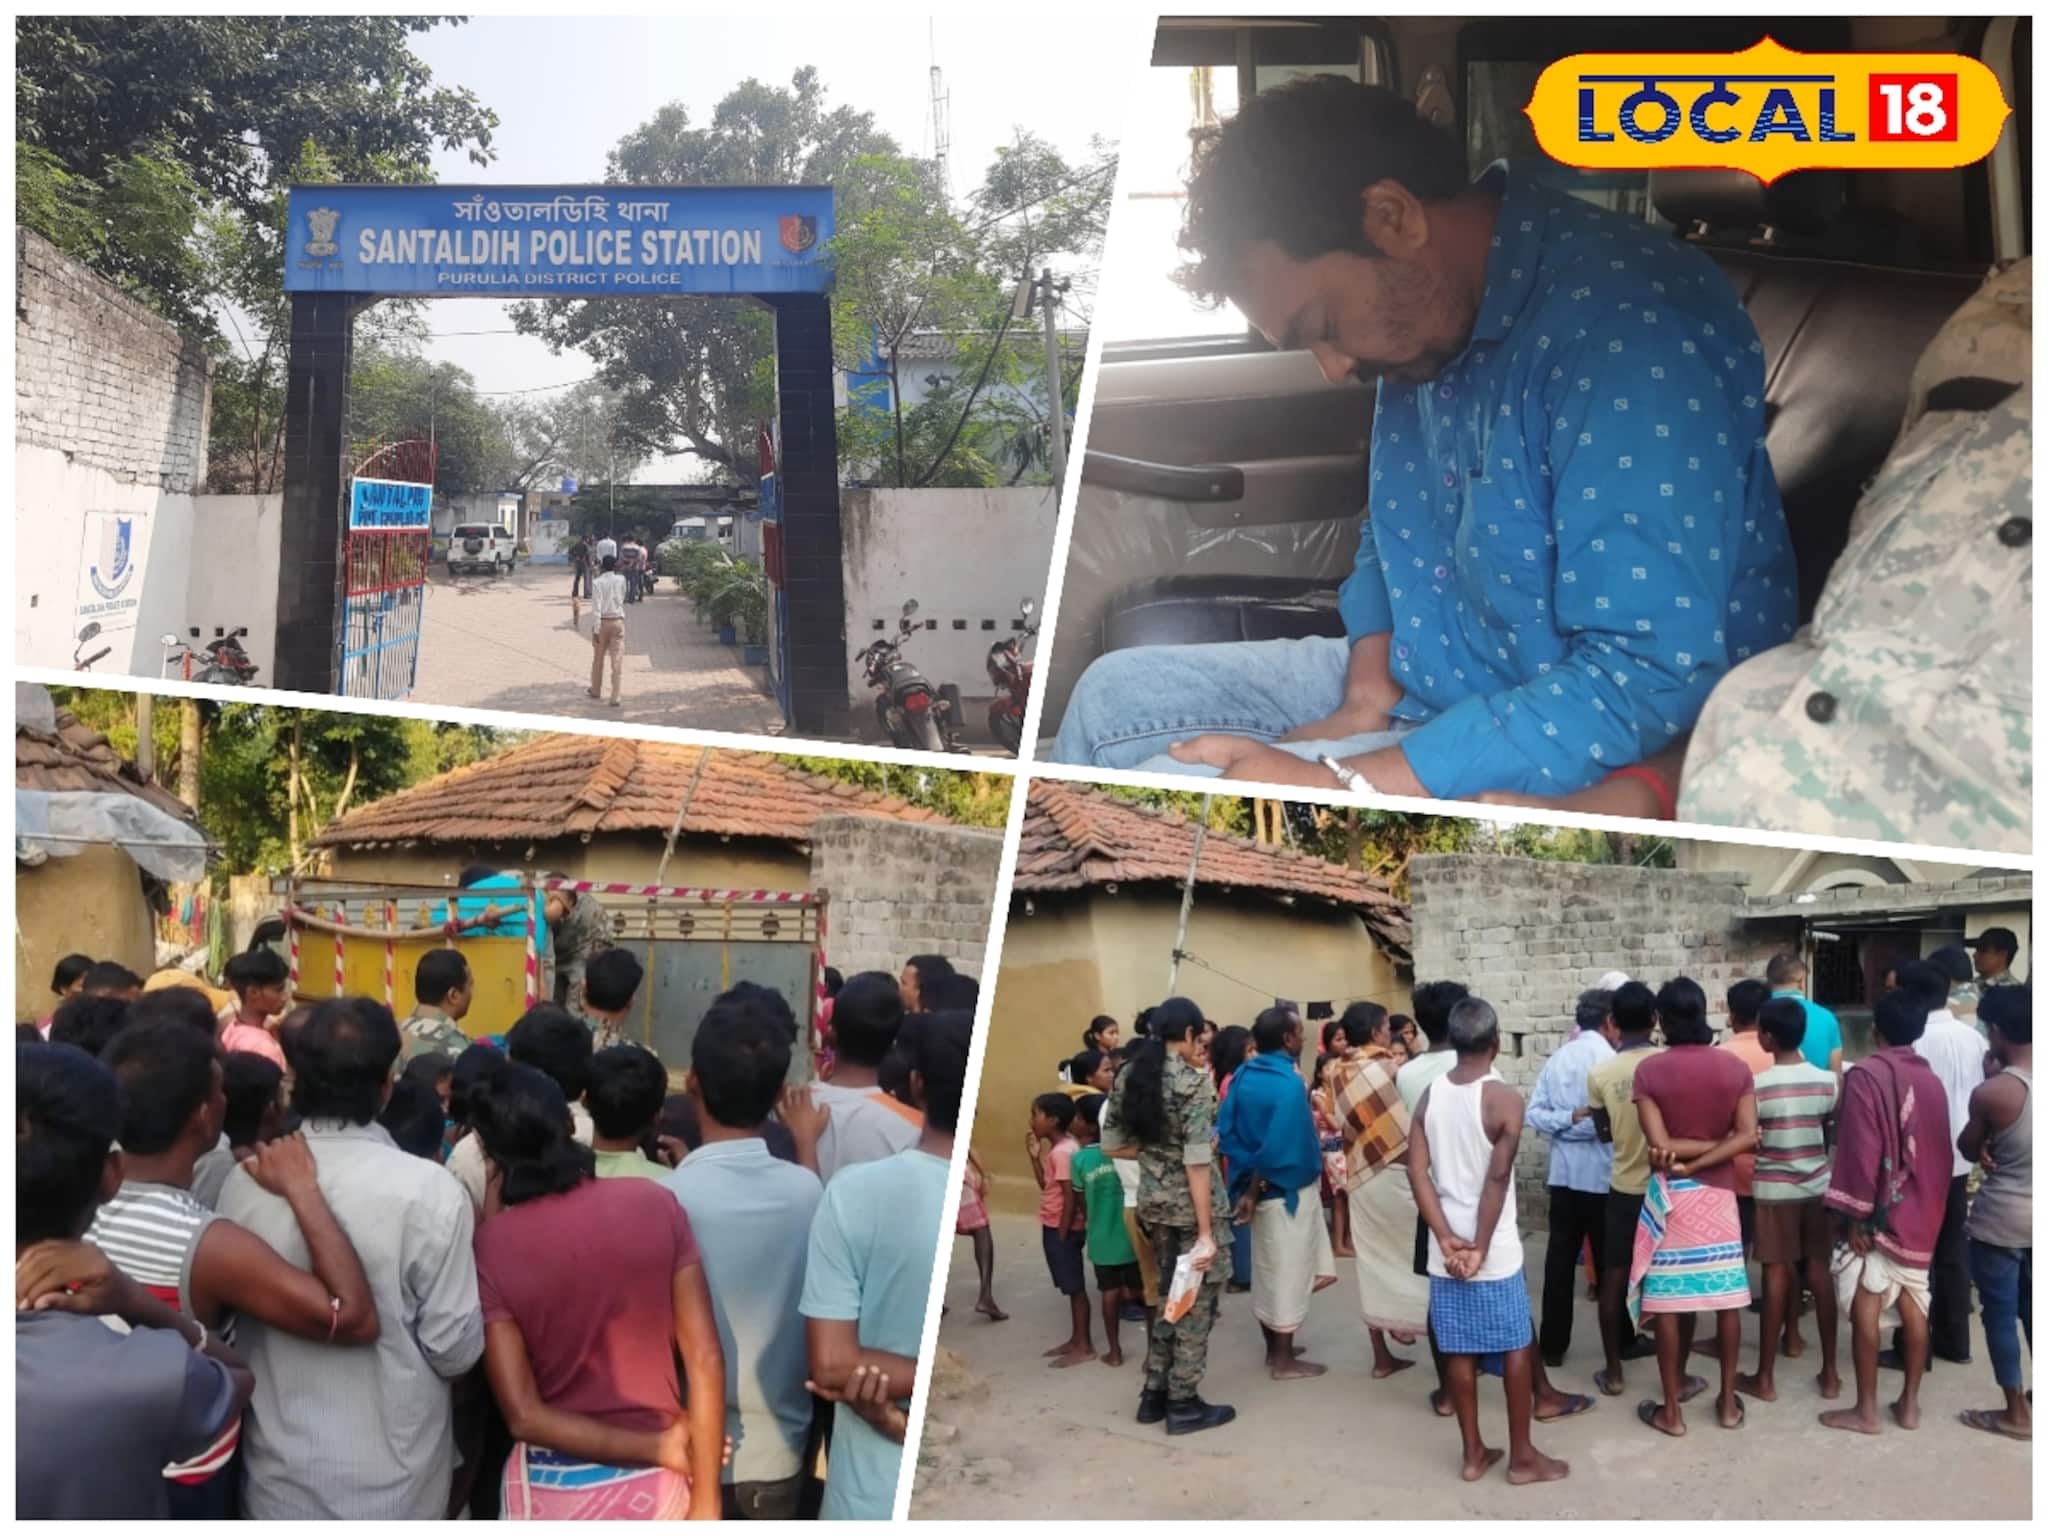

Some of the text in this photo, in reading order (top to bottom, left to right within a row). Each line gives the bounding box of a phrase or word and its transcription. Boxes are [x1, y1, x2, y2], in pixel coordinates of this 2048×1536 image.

[452, 194, 670, 222] সাঁওতালডিহি থানা
[359, 228, 761, 266] SANTALDIH POLICE STATION
[438, 272, 681, 285] PURULIA DISTRICT POLICE
